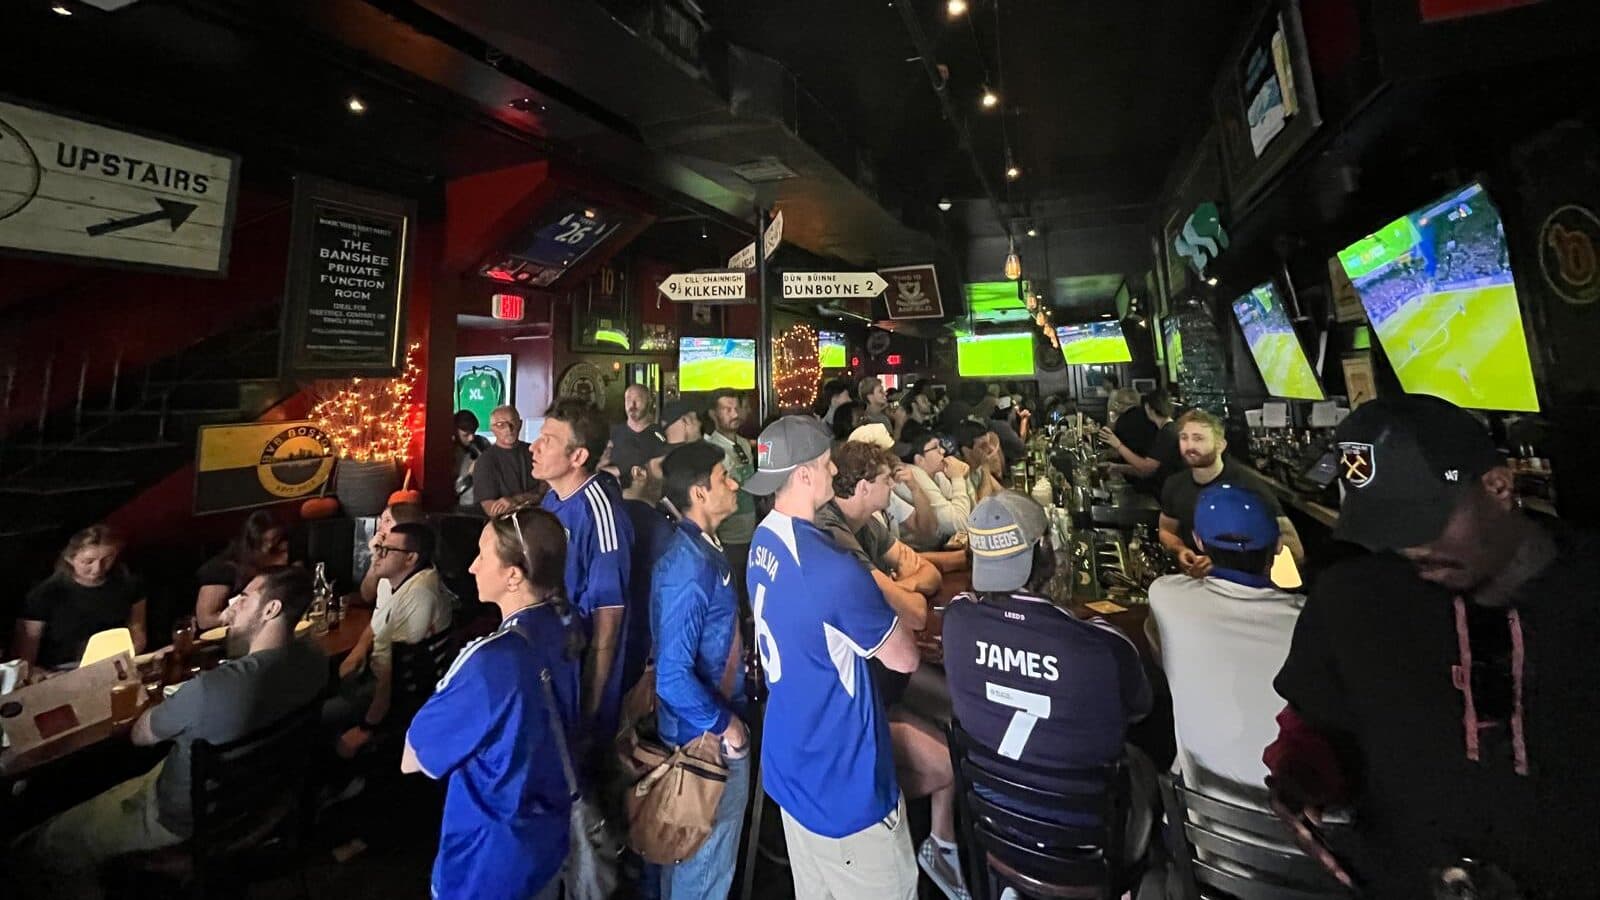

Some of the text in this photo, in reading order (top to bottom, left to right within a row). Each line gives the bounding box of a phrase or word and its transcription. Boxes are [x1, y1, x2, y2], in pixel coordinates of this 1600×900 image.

[57, 142, 209, 194] UPSTAIRS
[554, 222, 593, 244] 26
[342, 239, 372, 252] THE
[320, 248, 389, 266] BANSHEE
[328, 263, 382, 277] PRIVATE
[321, 275, 385, 289] FUNCTION
[602, 267, 614, 296] 10
[784, 281, 874, 295] DUNBOYNE 2
[335, 289, 370, 300] ROOM
[684, 285, 744, 297] KILKENNY
[469, 388, 484, 401] XL
[988, 530, 1020, 550] LEEDS
[755, 545, 779, 582] SILVA
[1004, 611, 1026, 621] LEEDS
[753, 582, 782, 684] 6
[976, 640, 1059, 681] JAMES
[985, 681, 1051, 761] 7
